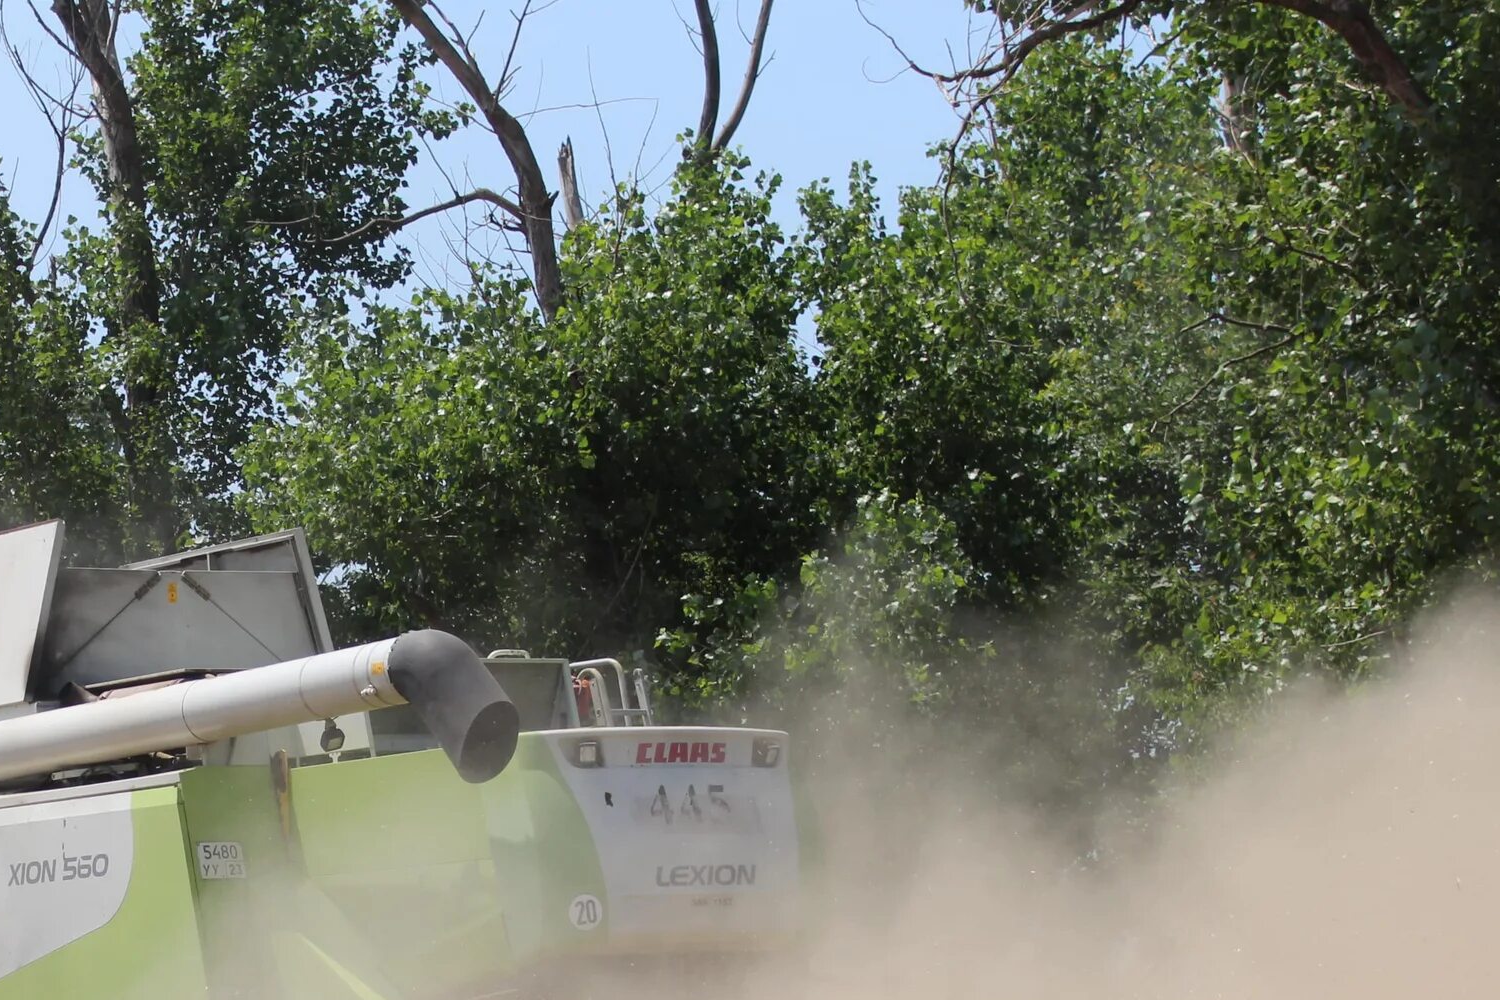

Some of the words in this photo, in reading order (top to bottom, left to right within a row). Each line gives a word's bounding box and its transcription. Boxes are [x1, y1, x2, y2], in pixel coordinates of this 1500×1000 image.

[636, 742, 726, 763] CLAAS
[203, 844, 238, 860] 5480
[8, 859, 57, 887] XION
[62, 853, 109, 881] 560
[229, 863, 244, 876] 23
[656, 865, 757, 887] LEXION
[575, 899, 597, 925] 20
